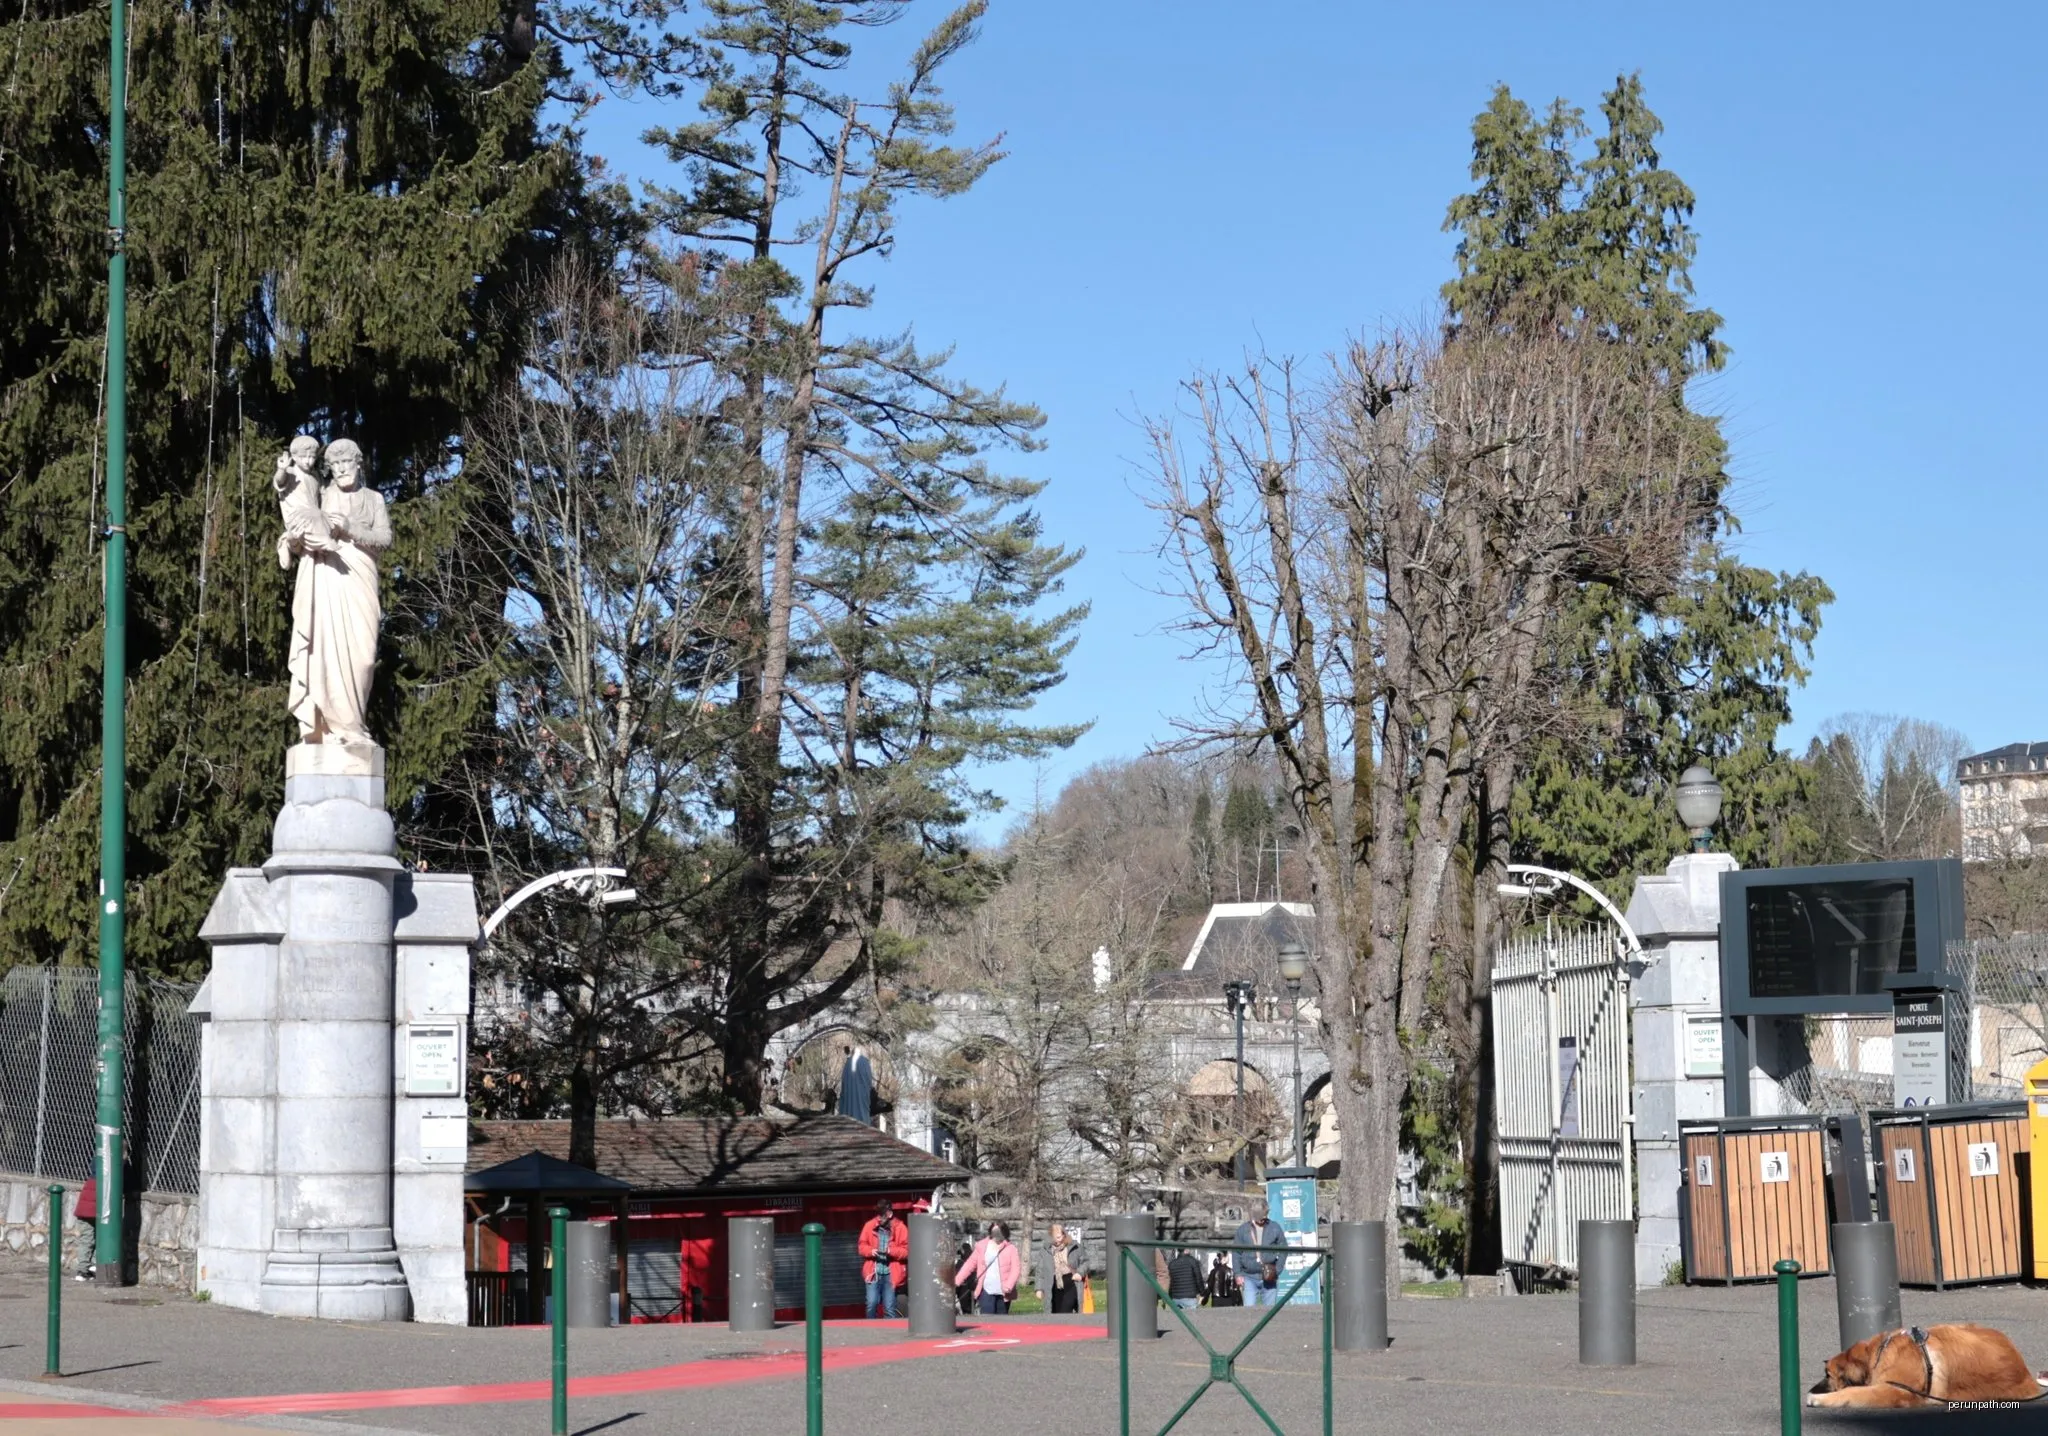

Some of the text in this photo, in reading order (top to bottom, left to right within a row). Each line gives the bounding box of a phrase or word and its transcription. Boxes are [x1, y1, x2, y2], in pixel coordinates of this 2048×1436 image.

[1909, 1003, 1928, 1012] PORTE
[1896, 1015, 1942, 1027] SAINT-JOSEPH
[1697, 1036, 1716, 1044] OPEN
[764, 1197, 802, 1206] LIBRAIRIE
